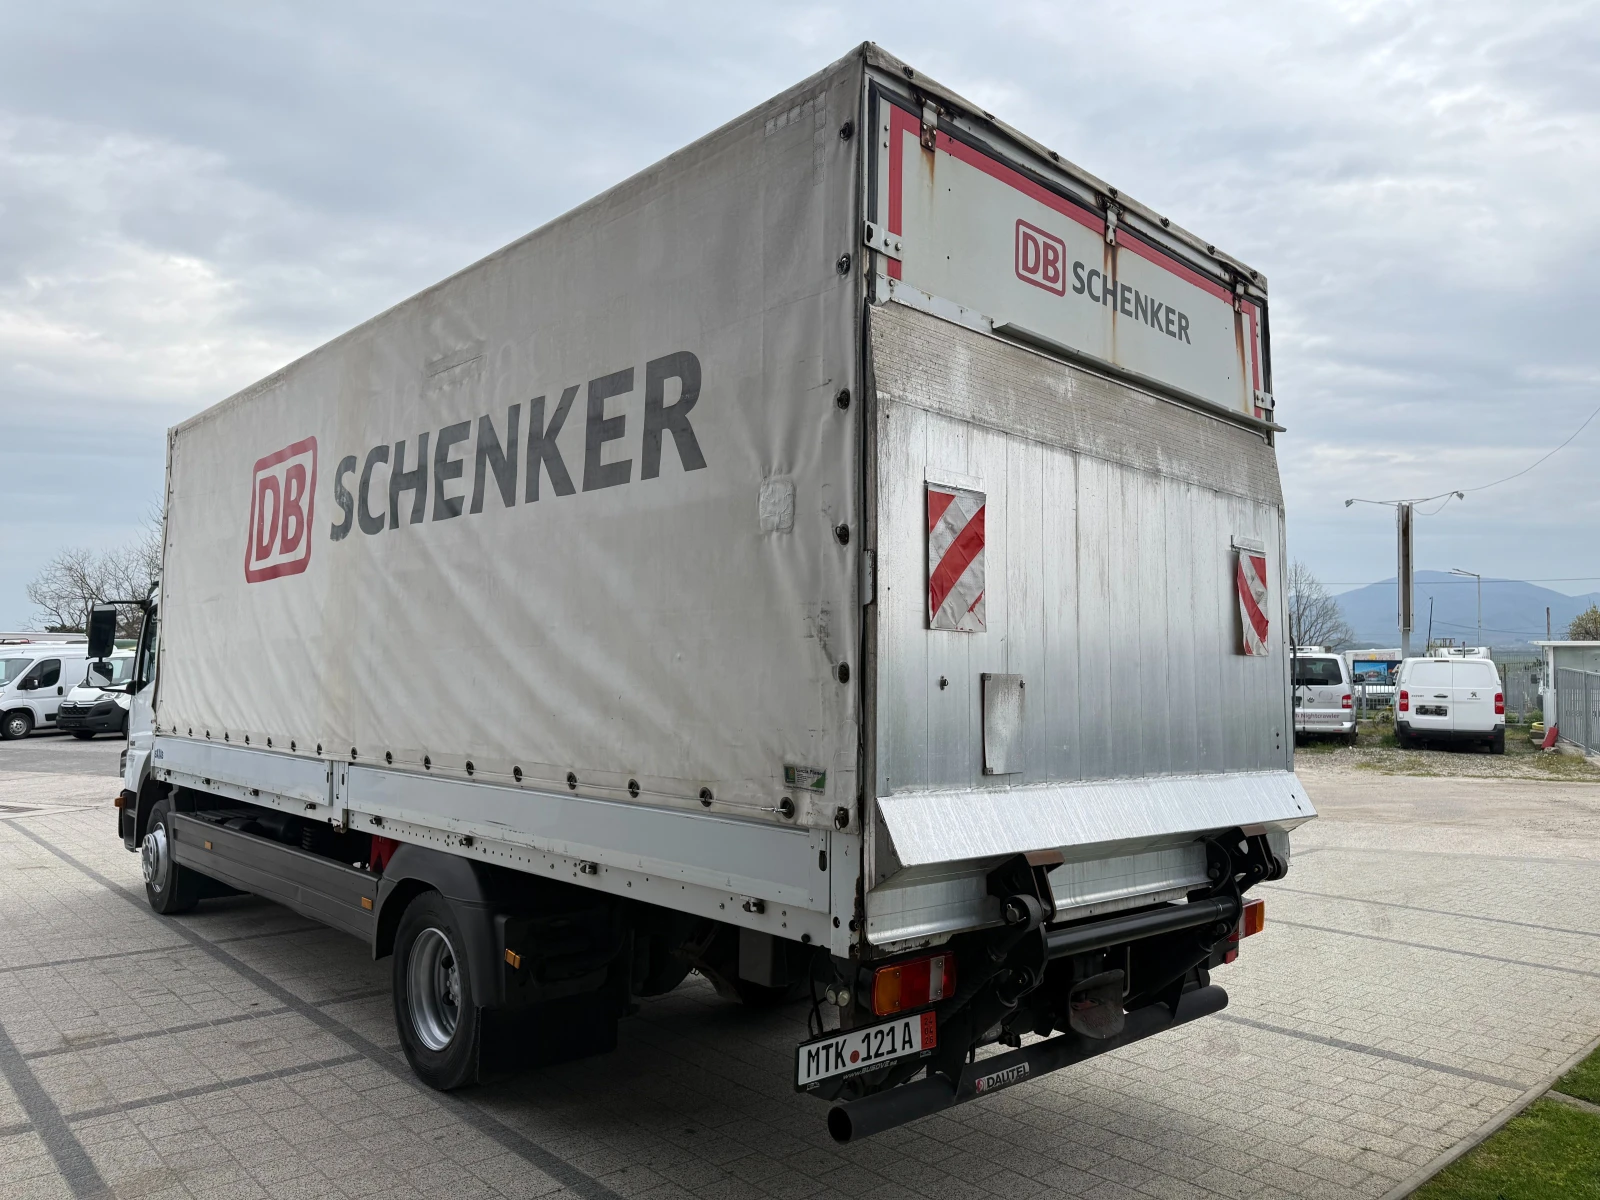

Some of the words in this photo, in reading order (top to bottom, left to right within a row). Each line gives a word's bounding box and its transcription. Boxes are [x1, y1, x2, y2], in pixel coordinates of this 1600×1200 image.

[1021, 230, 1060, 285] DB
[1072, 260, 1192, 345] SCHENKER
[255, 462, 307, 563] DB
[330, 350, 707, 542] SCHENKER
[806, 1038, 848, 1079] MTK
[860, 1021, 914, 1063] 121A
[924, 1016, 934, 1026] 24
[986, 1064, 1030, 1089] DAUTEL
